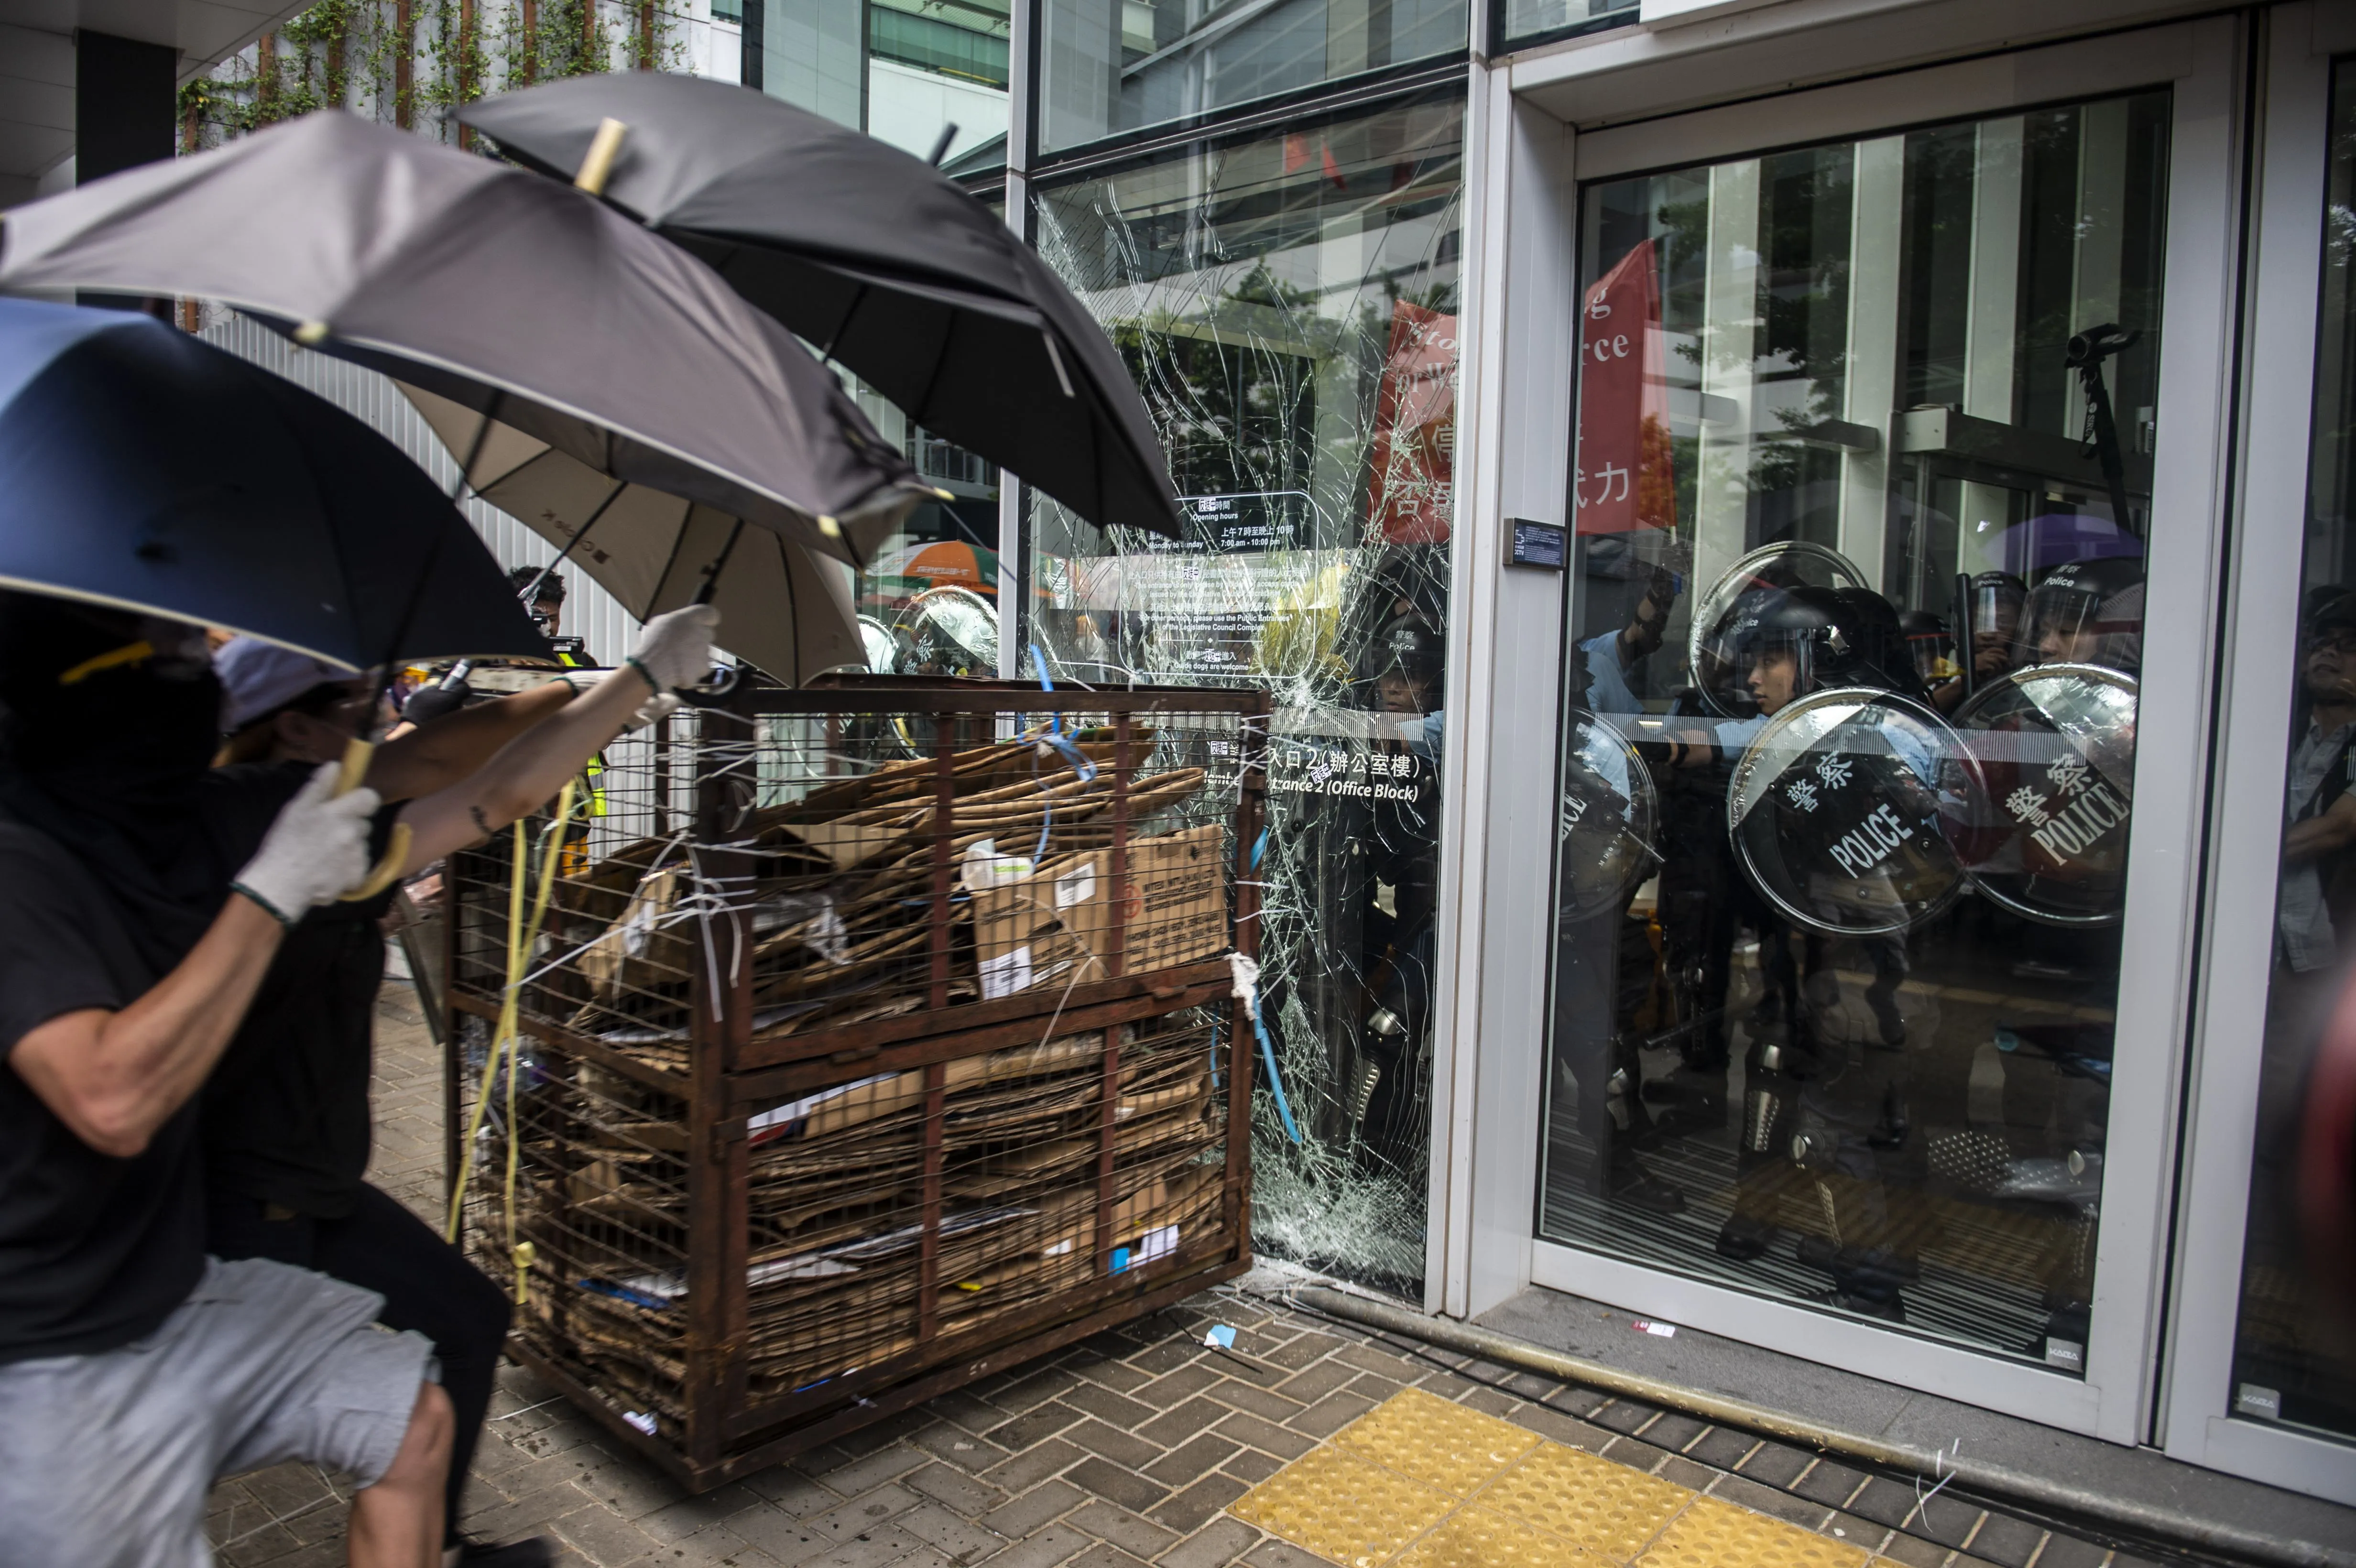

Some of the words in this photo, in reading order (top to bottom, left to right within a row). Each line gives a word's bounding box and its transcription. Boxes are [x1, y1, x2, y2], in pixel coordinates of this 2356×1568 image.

[1584, 287, 1612, 320] g
[1409, 322, 1456, 349] Sto
[1431, 424, 1453, 463] 停
[1193, 513, 1218, 522] Opening
[2044, 576, 2075, 588] Police
[1389, 642, 1415, 650] Police
[1193, 663, 1209, 671] dogs
[1211, 741, 1228, 754] 反送中
[1311, 764, 1331, 783] 反送中
[1787, 750, 1853, 813] 警察
[1268, 776, 1316, 792] trance
[1316, 781, 1324, 794] 2
[1326, 780, 1374, 797] (Office
[1374, 784, 1419, 803] Block)
[2005, 752, 2092, 827] 警察
[2030, 781, 2130, 866] POLICE
[1828, 803, 1914, 879] POLICE
